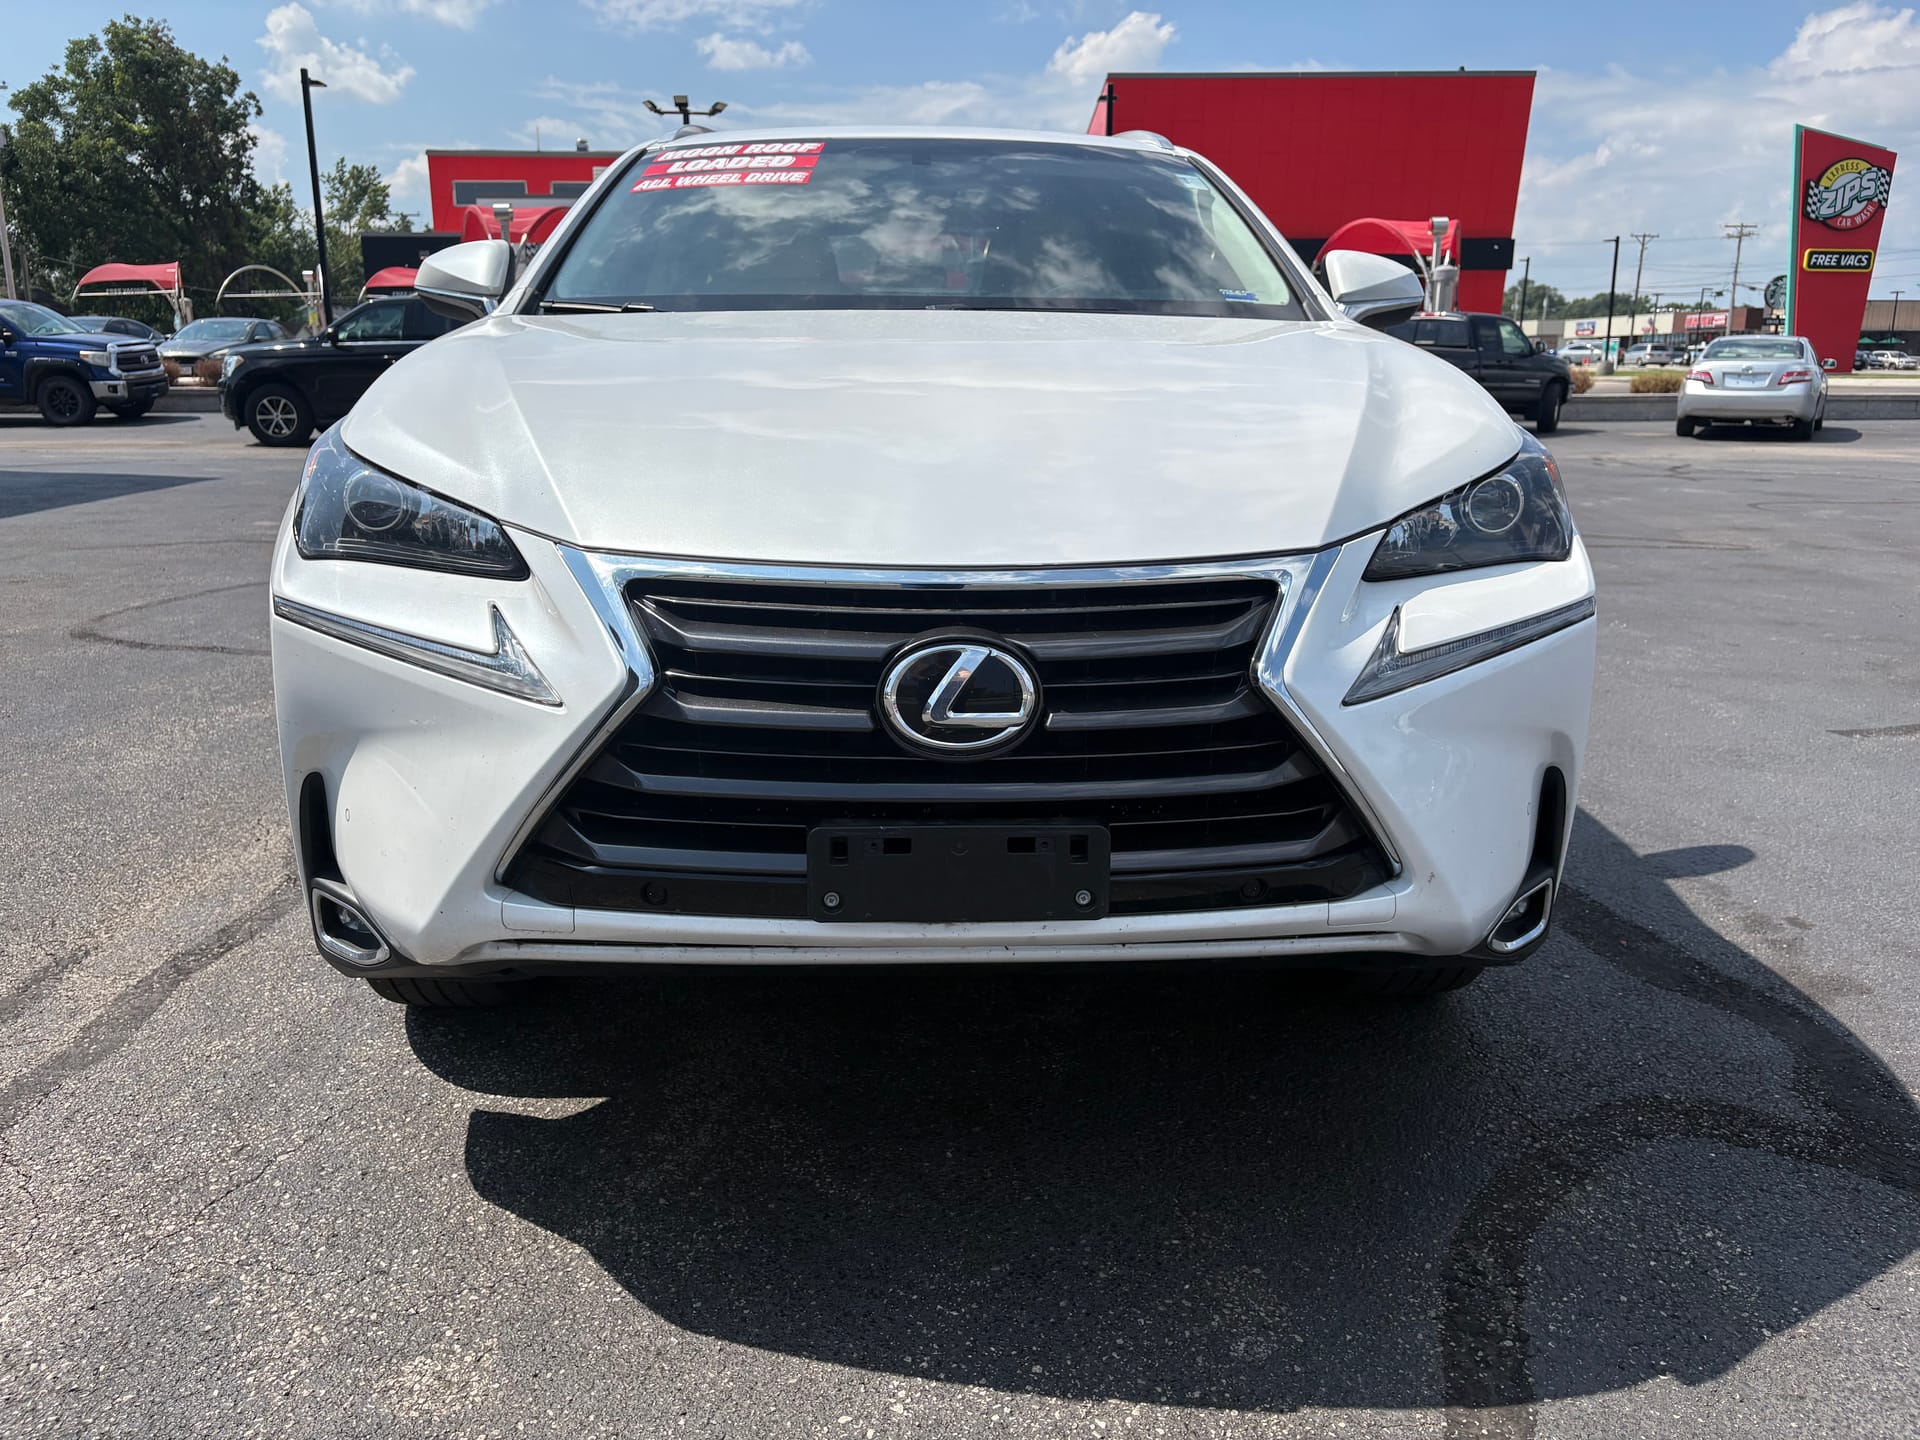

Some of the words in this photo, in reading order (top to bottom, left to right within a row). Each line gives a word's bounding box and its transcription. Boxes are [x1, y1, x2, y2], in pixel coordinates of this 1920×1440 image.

[658, 144, 742, 162] MOON
[743, 142, 821, 154] ROOF
[666, 155, 796, 173] LOADED
[1826, 161, 1860, 182] EXPRESS
[632, 178, 672, 191] ALL
[675, 173, 742, 187] WHEEL
[744, 171, 808, 183] DRIVE
[1818, 171, 1878, 216] ZIPS
[1837, 217, 1852, 226] CAR
[1855, 204, 1875, 225] WASH
[1810, 254, 1839, 266] FREE
[1841, 254, 1869, 266] VACS
